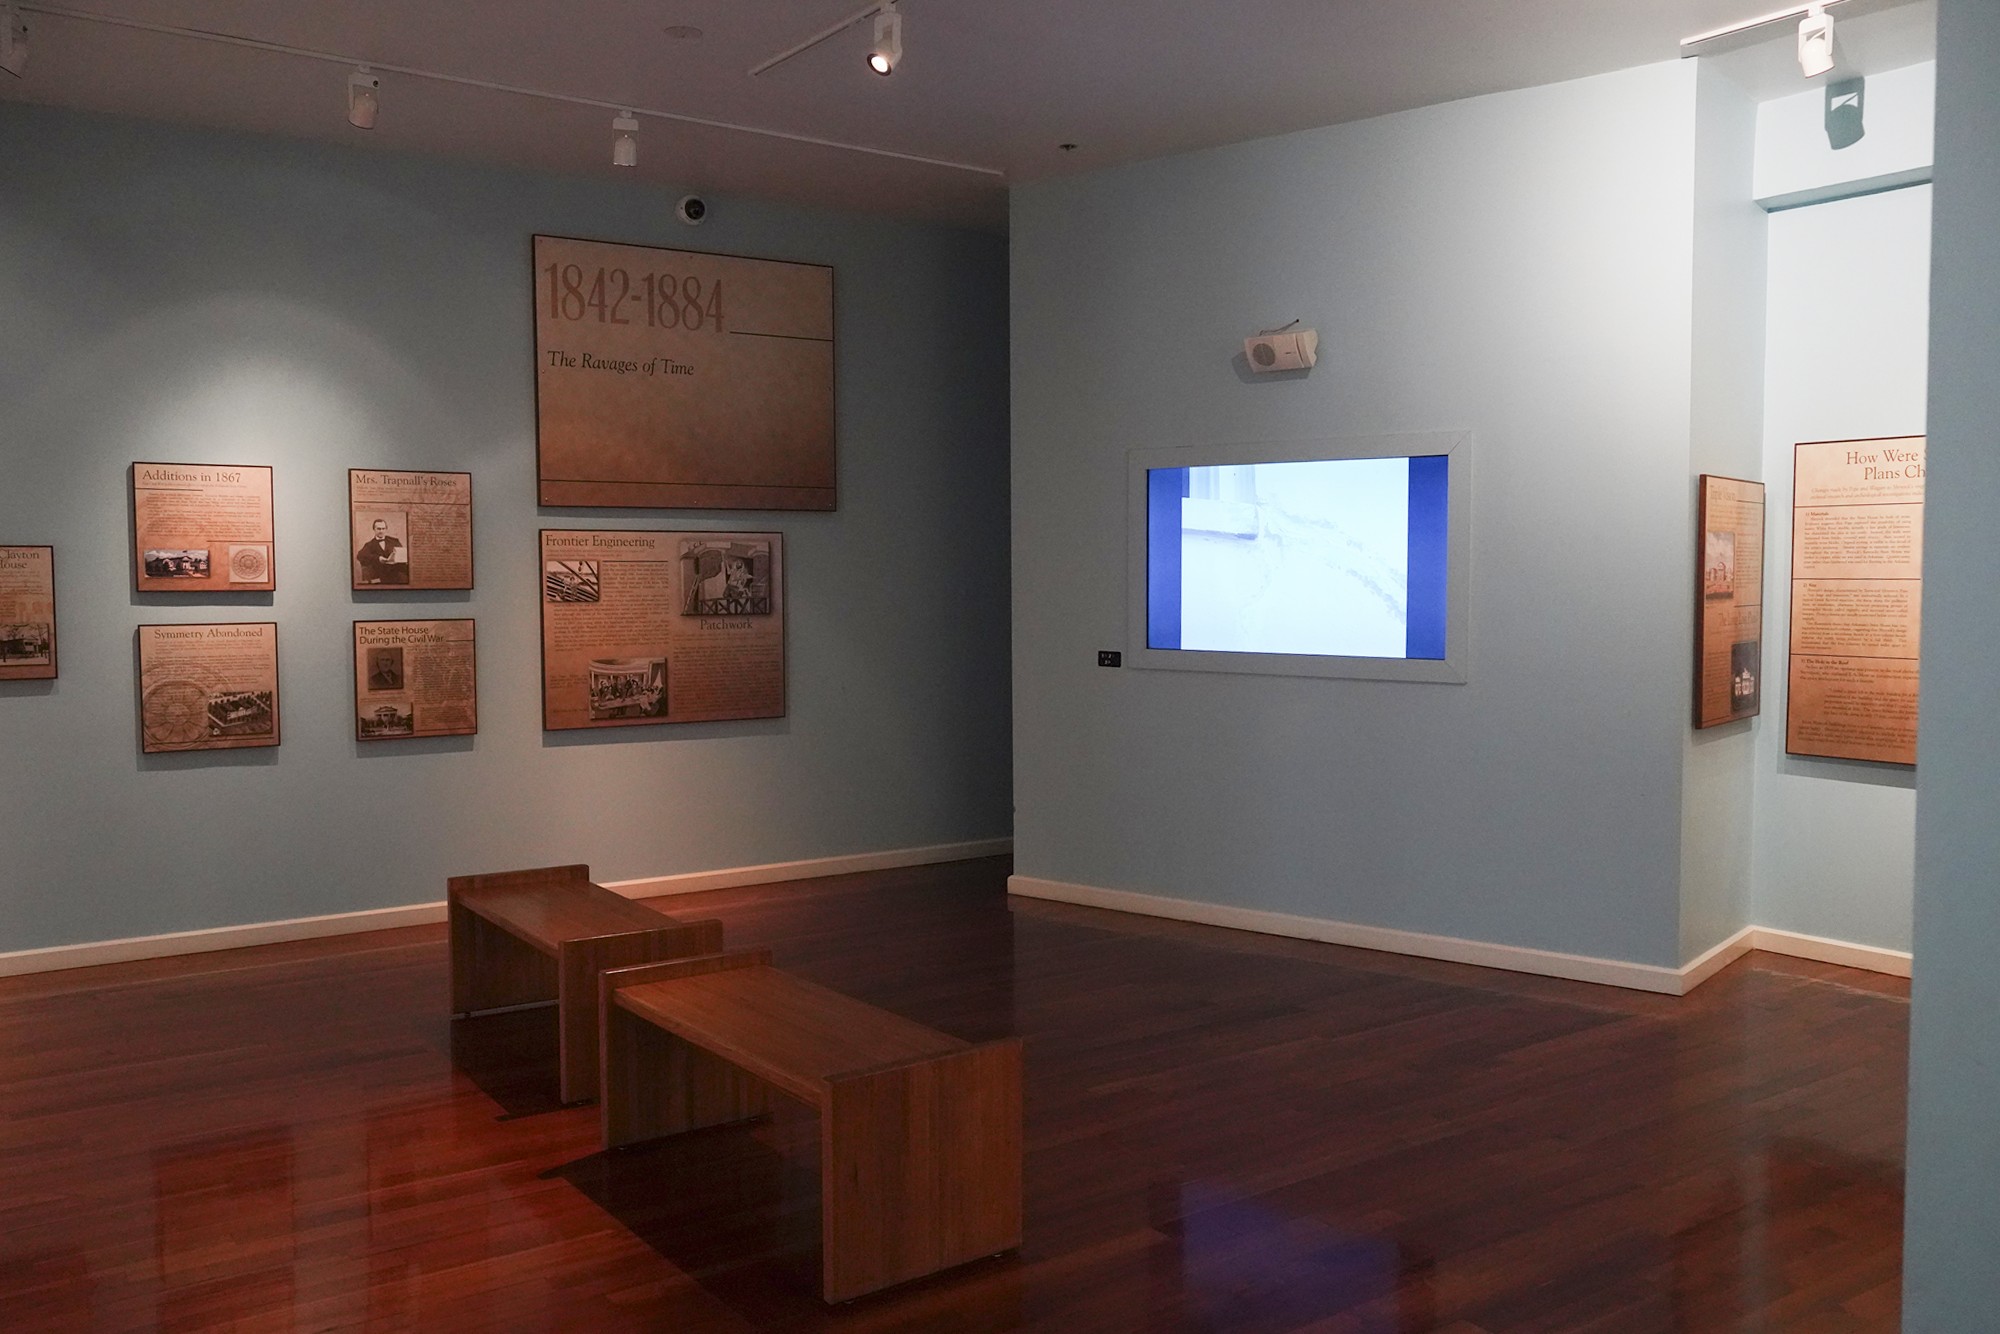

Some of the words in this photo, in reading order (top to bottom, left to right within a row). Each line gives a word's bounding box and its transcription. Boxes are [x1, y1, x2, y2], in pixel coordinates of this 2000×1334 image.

[544, 262, 725, 334] 1842-1884
[547, 351, 576, 369] The
[582, 353, 638, 376] Ravages
[642, 357, 659, 380] of
[660, 358, 695, 377] Time
[1846, 451, 1878, 465] How
[1883, 449, 1919, 462] Were
[142, 469, 198, 482] Additions
[200, 471, 212, 482] in
[216, 472, 241, 483] 1867
[1864, 466, 1901, 480] Plans
[355, 474, 378, 484] Mrs.
[381, 474, 428, 488] Trapnall's
[430, 477, 457, 487] Roses
[545, 535, 590, 548] Frontier
[592, 536, 656, 550] Engineering
[359, 627, 376, 636] The
[377, 626, 400, 636] State
[401, 626, 429, 634] House
[700, 619, 753, 631] Patchwork
[154, 629, 204, 642] Symmetry
[206, 627, 263, 638] Abandoned
[359, 635, 390, 646] During
[391, 635, 406, 644] the
[407, 634, 426, 644] Civil
[427, 634, 445, 643] War
